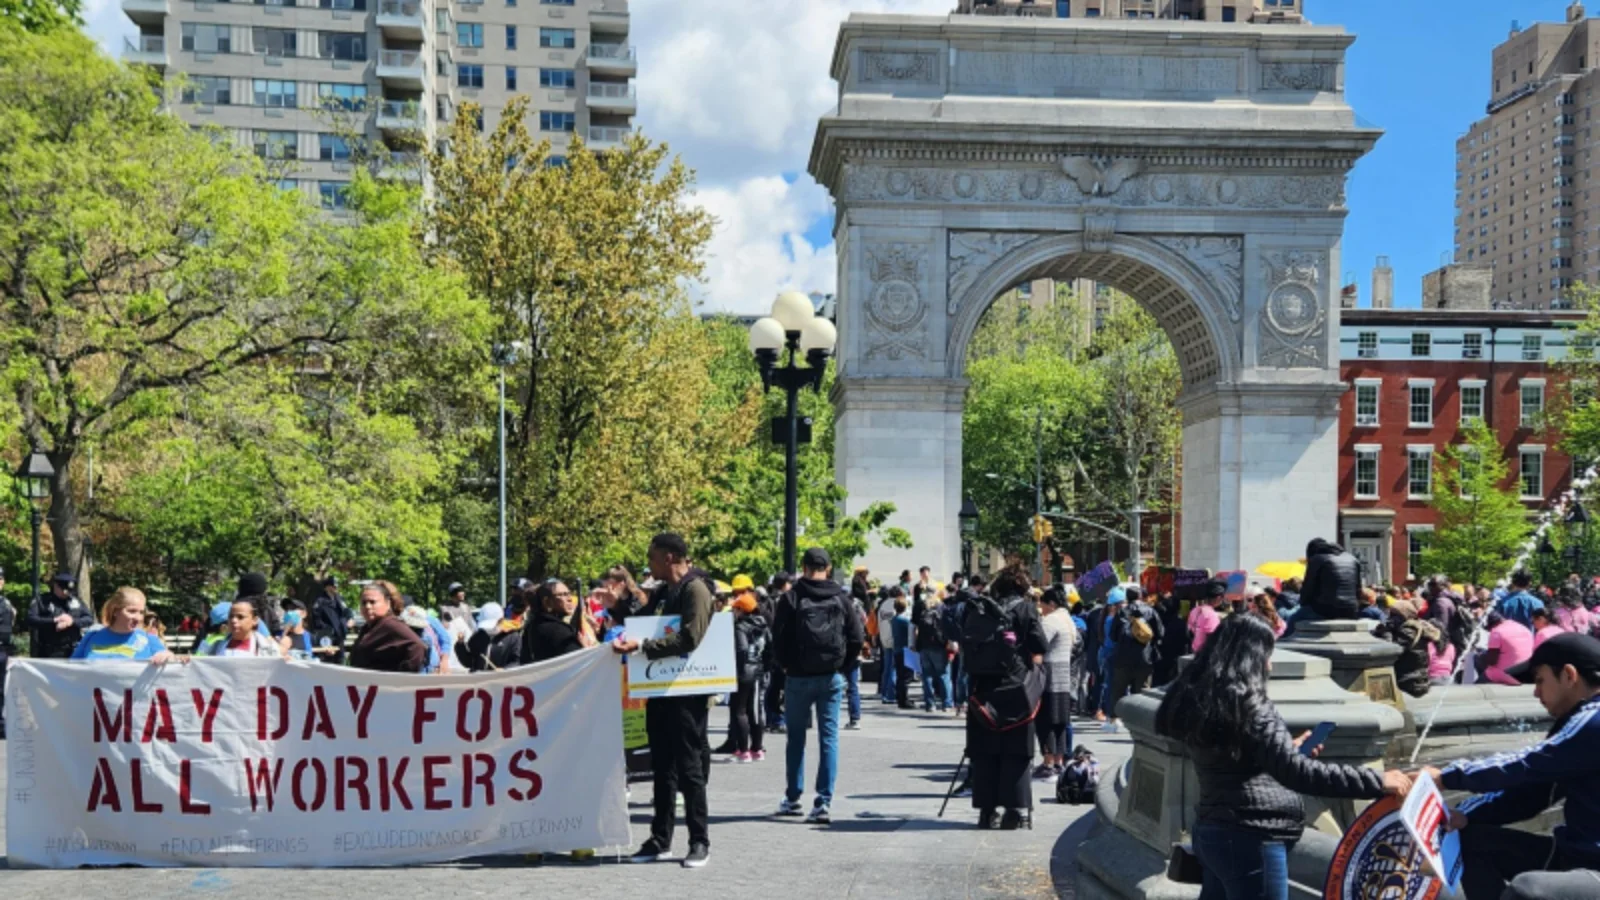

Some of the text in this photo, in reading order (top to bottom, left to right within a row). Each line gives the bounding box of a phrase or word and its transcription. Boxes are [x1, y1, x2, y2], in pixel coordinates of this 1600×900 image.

[93, 685, 539, 744] MAY DAY FOR
[86, 748, 543, 815] ALL WORKERS
